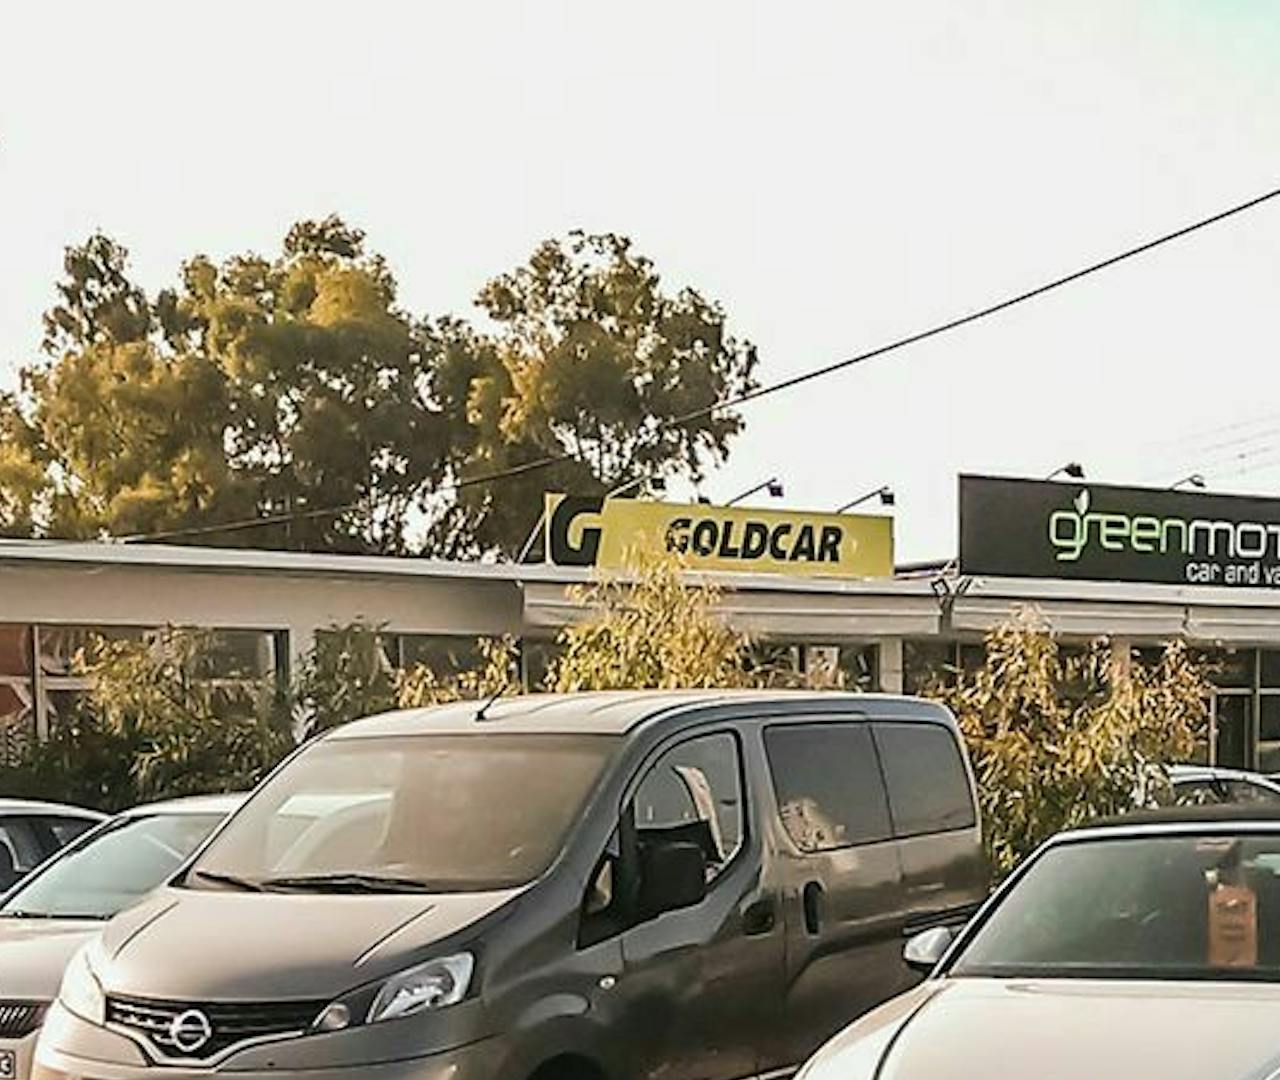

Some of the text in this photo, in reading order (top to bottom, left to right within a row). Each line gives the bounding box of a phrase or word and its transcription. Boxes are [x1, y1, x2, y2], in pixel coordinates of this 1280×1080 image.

[666, 517, 843, 562] GOLDCAR
[1186, 562, 1220, 583] car
[1224, 561, 1261, 585] and
